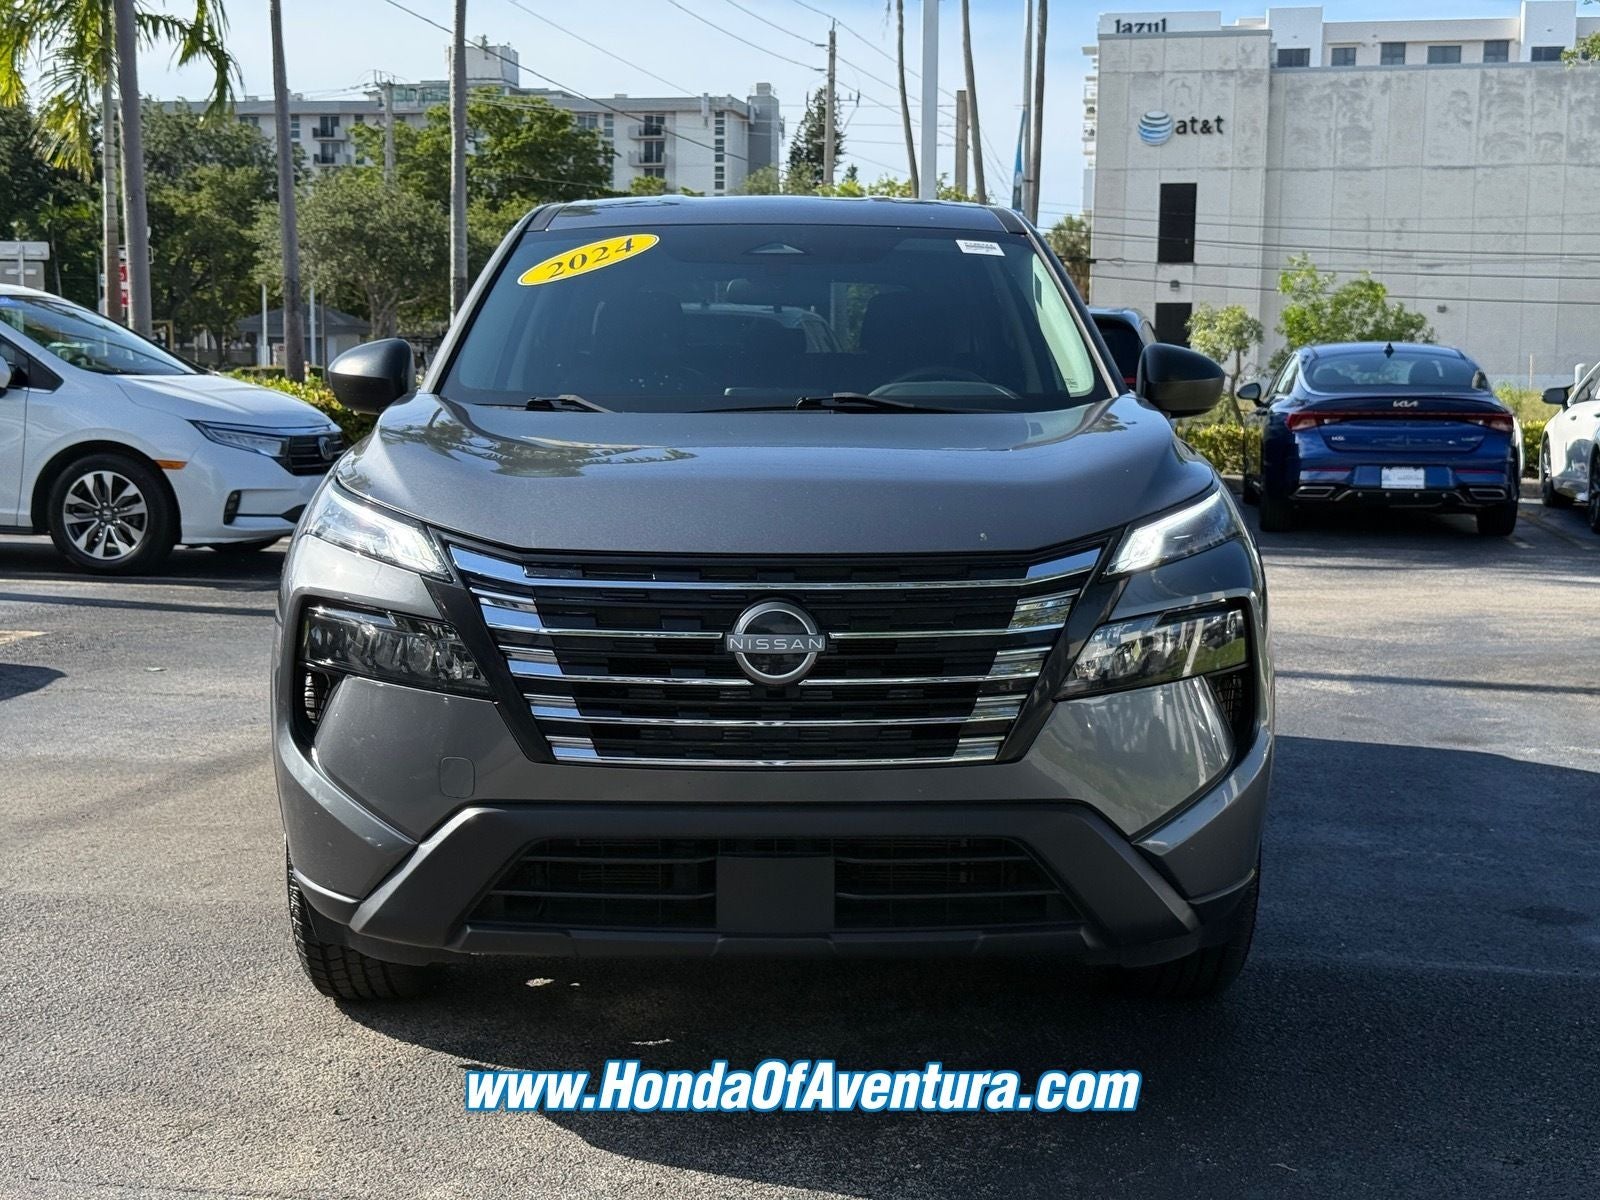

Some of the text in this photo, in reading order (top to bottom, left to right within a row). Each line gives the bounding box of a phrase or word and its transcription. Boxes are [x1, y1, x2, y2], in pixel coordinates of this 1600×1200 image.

[1115, 18, 1167, 33] lazul
[1175, 115, 1224, 135] at&t
[546, 238, 634, 279] 2024
[729, 638, 823, 650] NISSAN
